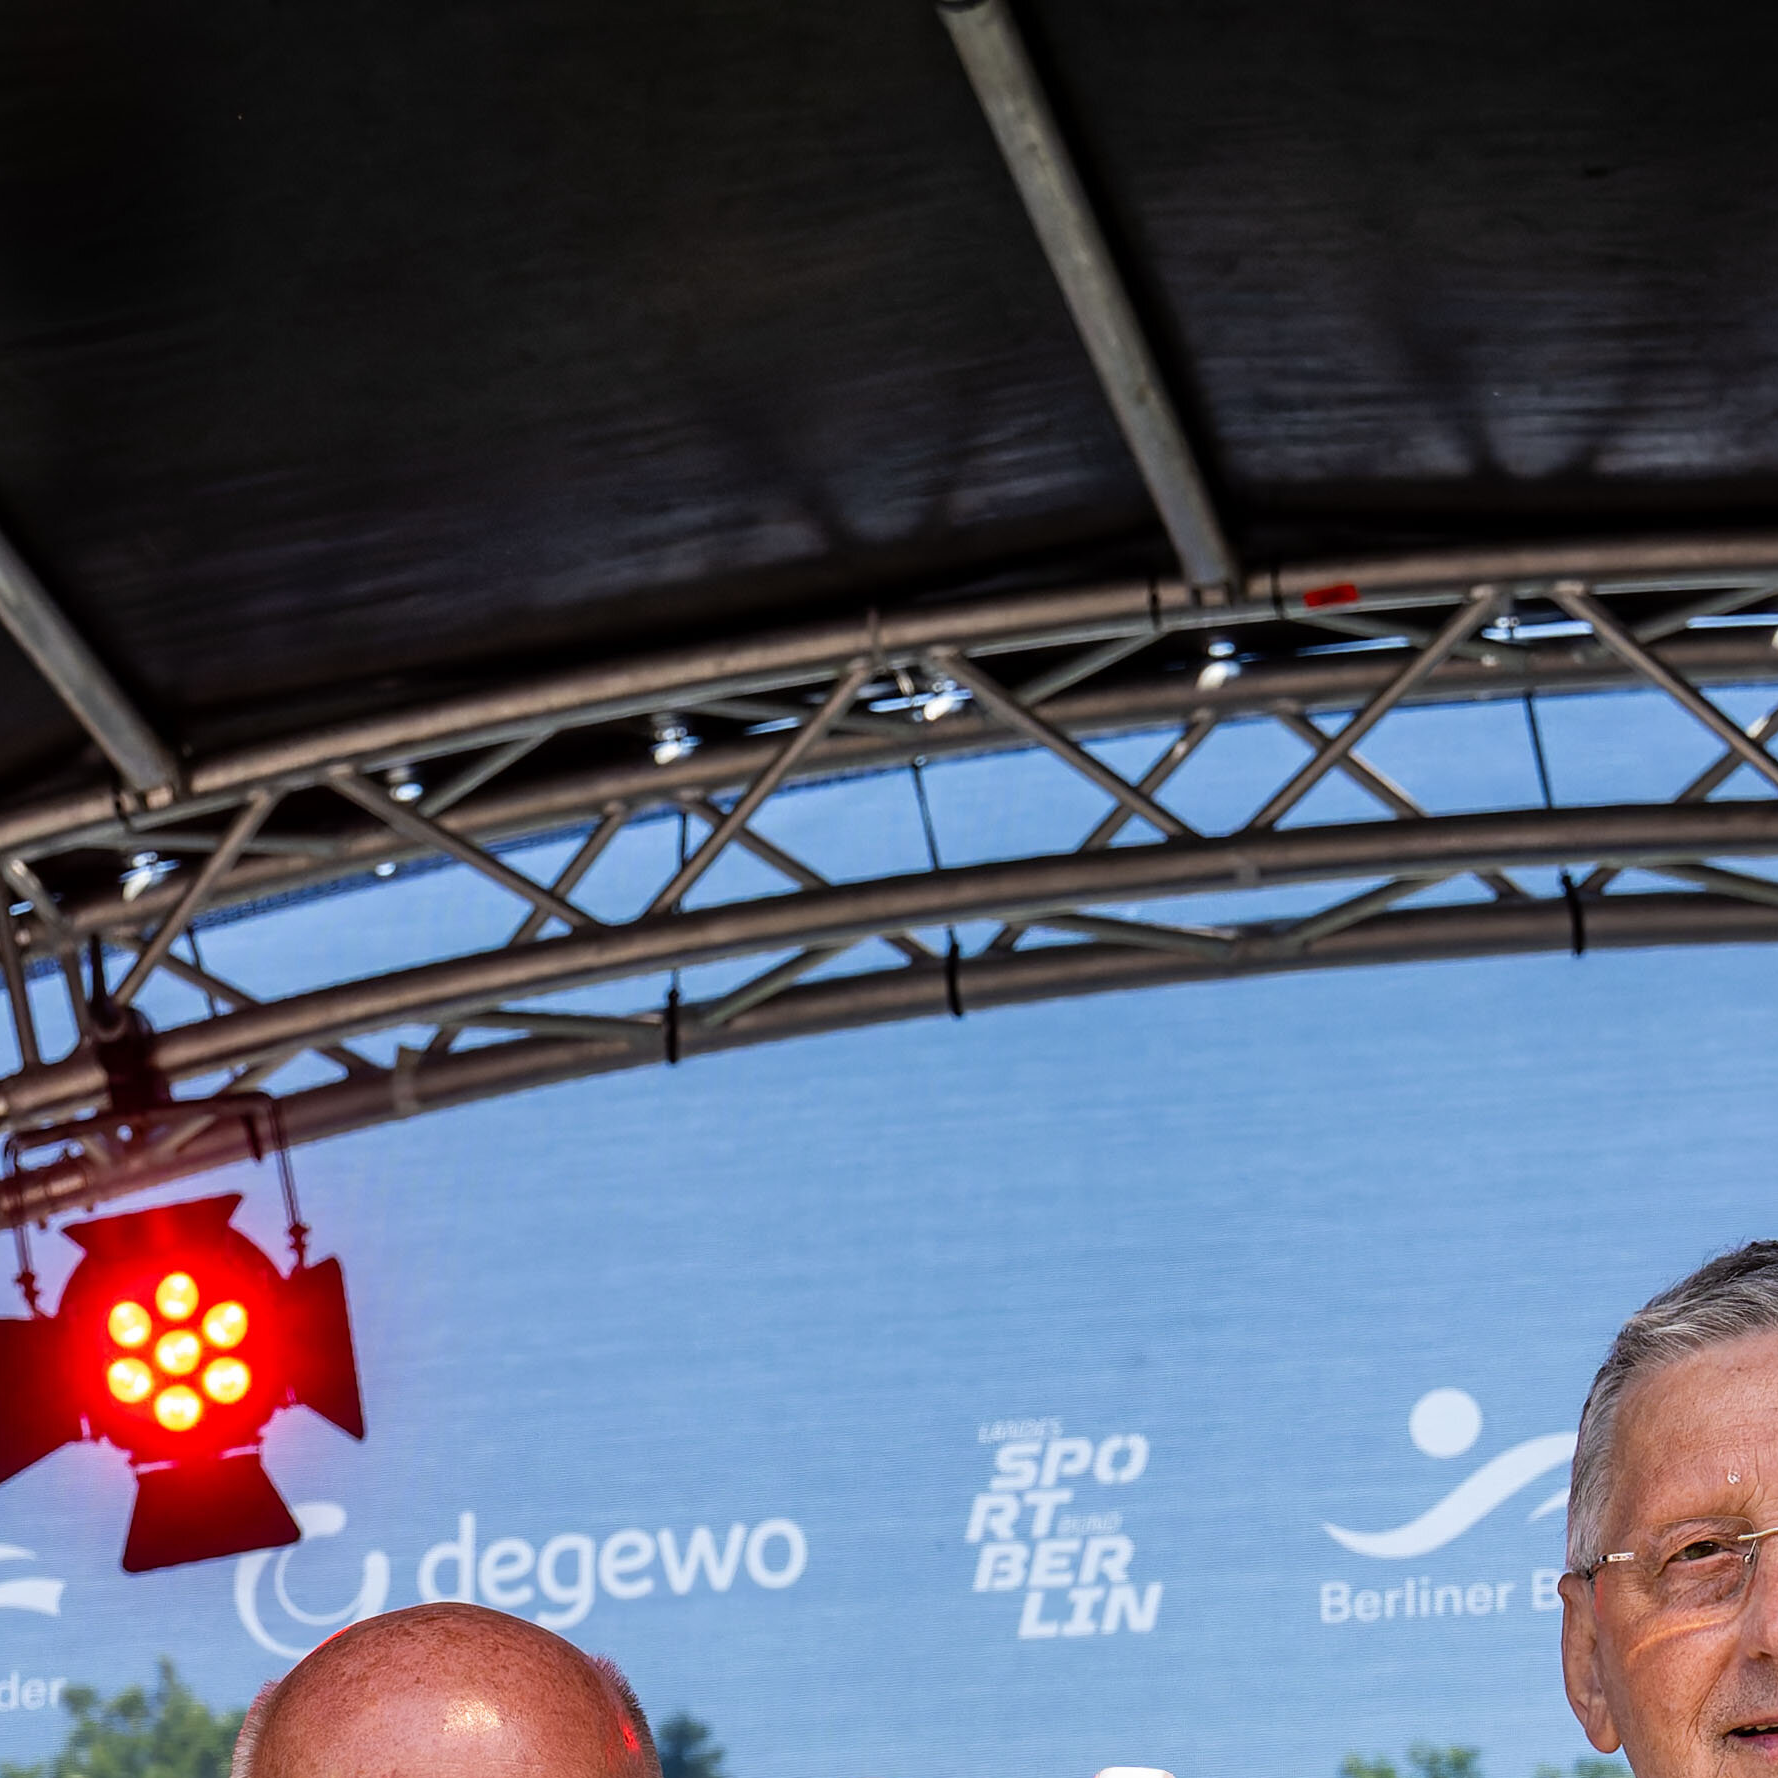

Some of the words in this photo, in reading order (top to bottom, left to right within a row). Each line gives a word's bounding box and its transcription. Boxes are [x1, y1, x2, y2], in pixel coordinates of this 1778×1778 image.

[989, 1433, 1150, 1490] SPO
[964, 1487, 1074, 1543] RT
[416, 1511, 809, 1631] degewo
[971, 1534, 1135, 1592] BER
[1017, 1580, 1164, 1640] LIN
[1321, 1575, 1516, 1623] Berliner
